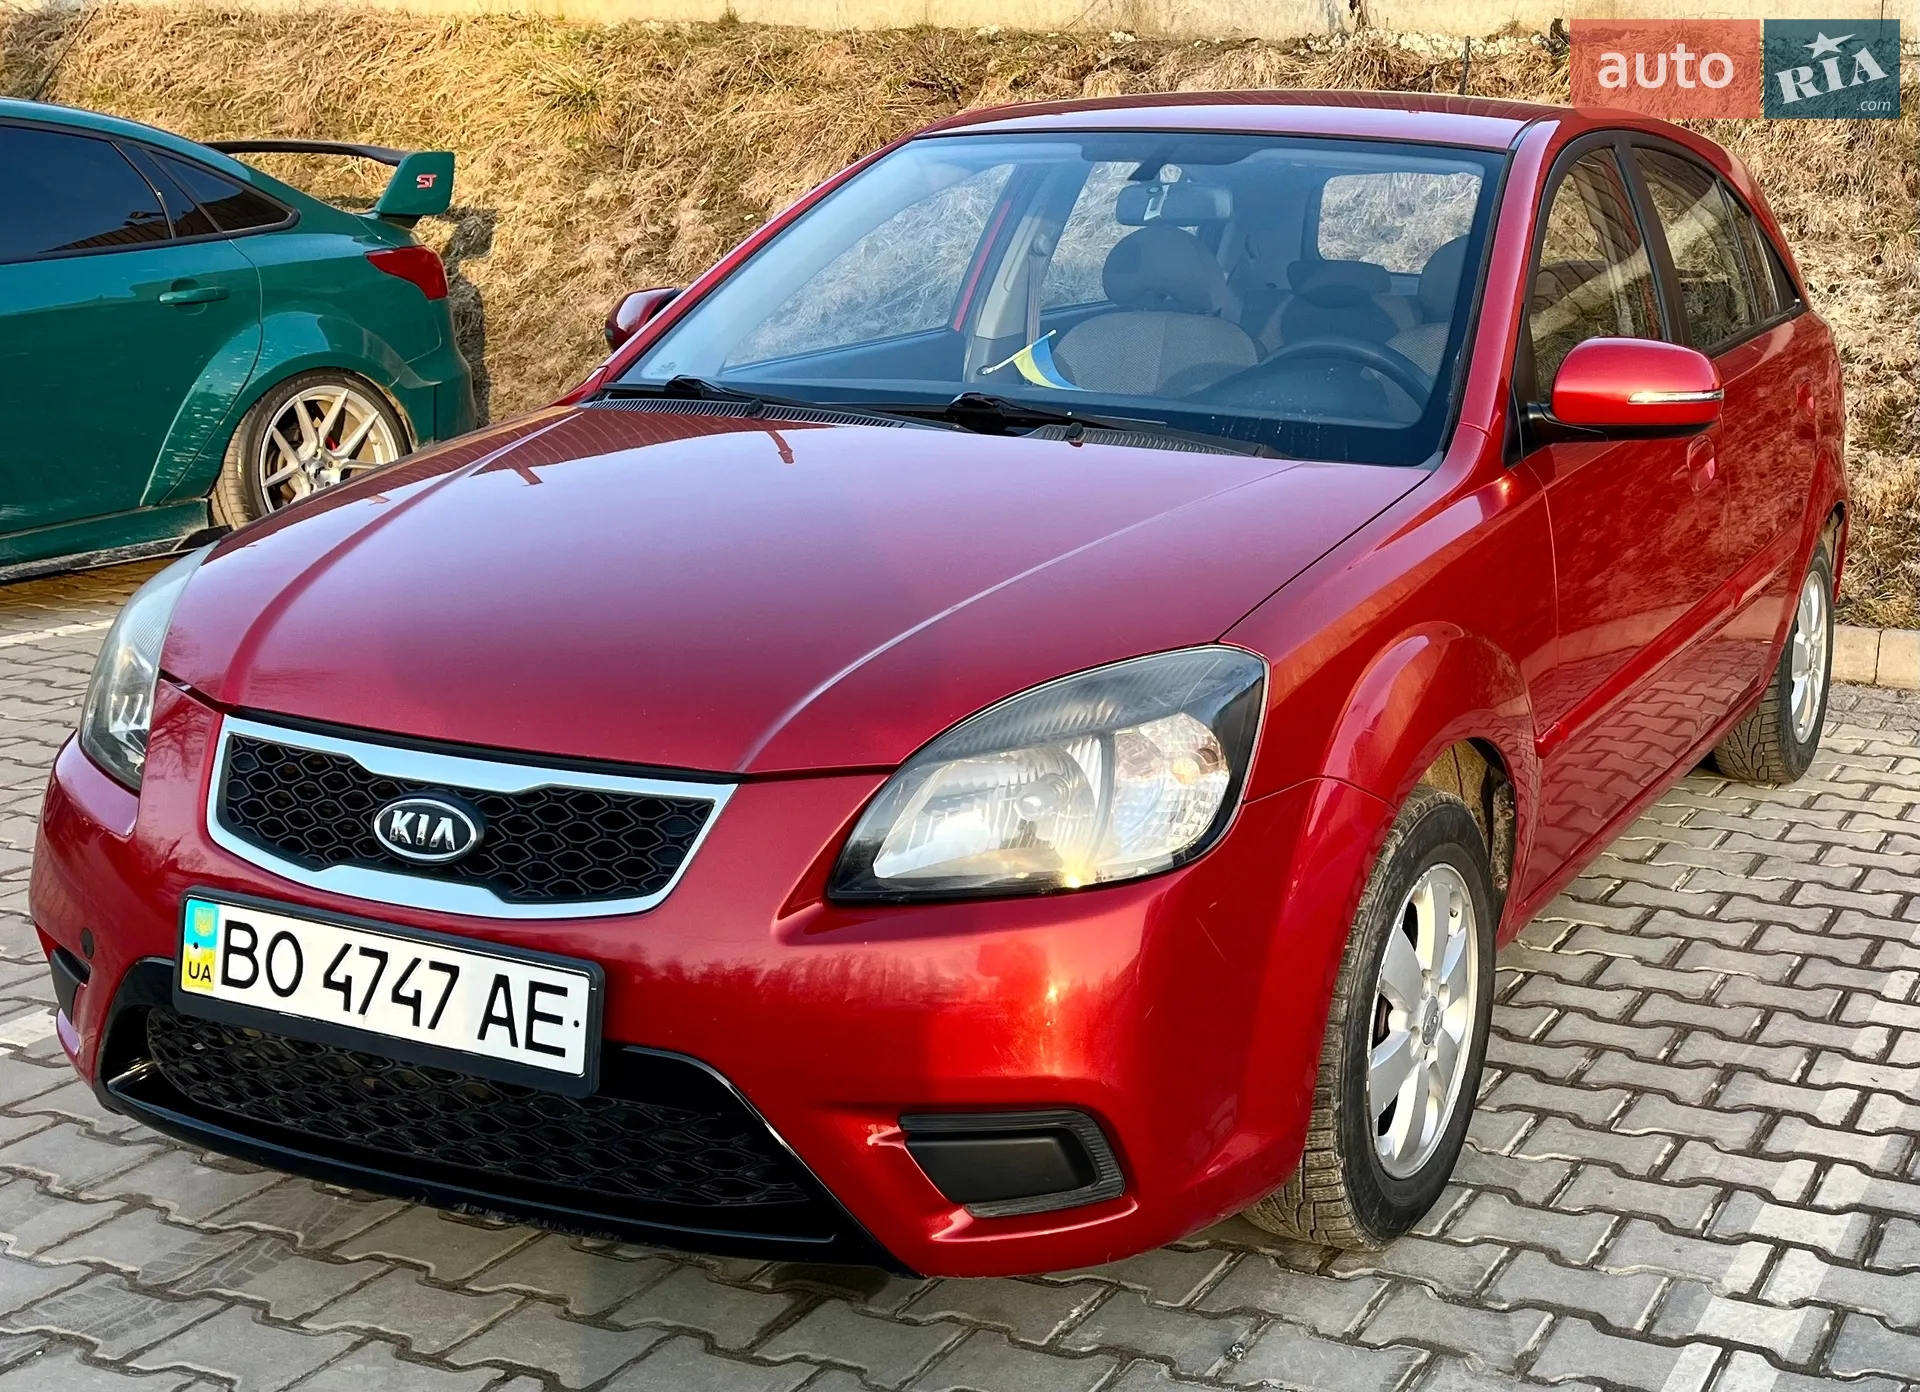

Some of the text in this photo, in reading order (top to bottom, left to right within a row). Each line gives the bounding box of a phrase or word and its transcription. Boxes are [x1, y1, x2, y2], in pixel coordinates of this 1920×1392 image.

[416, 174, 437, 188] ST
[389, 810, 455, 850] KIA
[188, 960, 212, 983] UA
[221, 919, 568, 1058] BO 4747 AE
